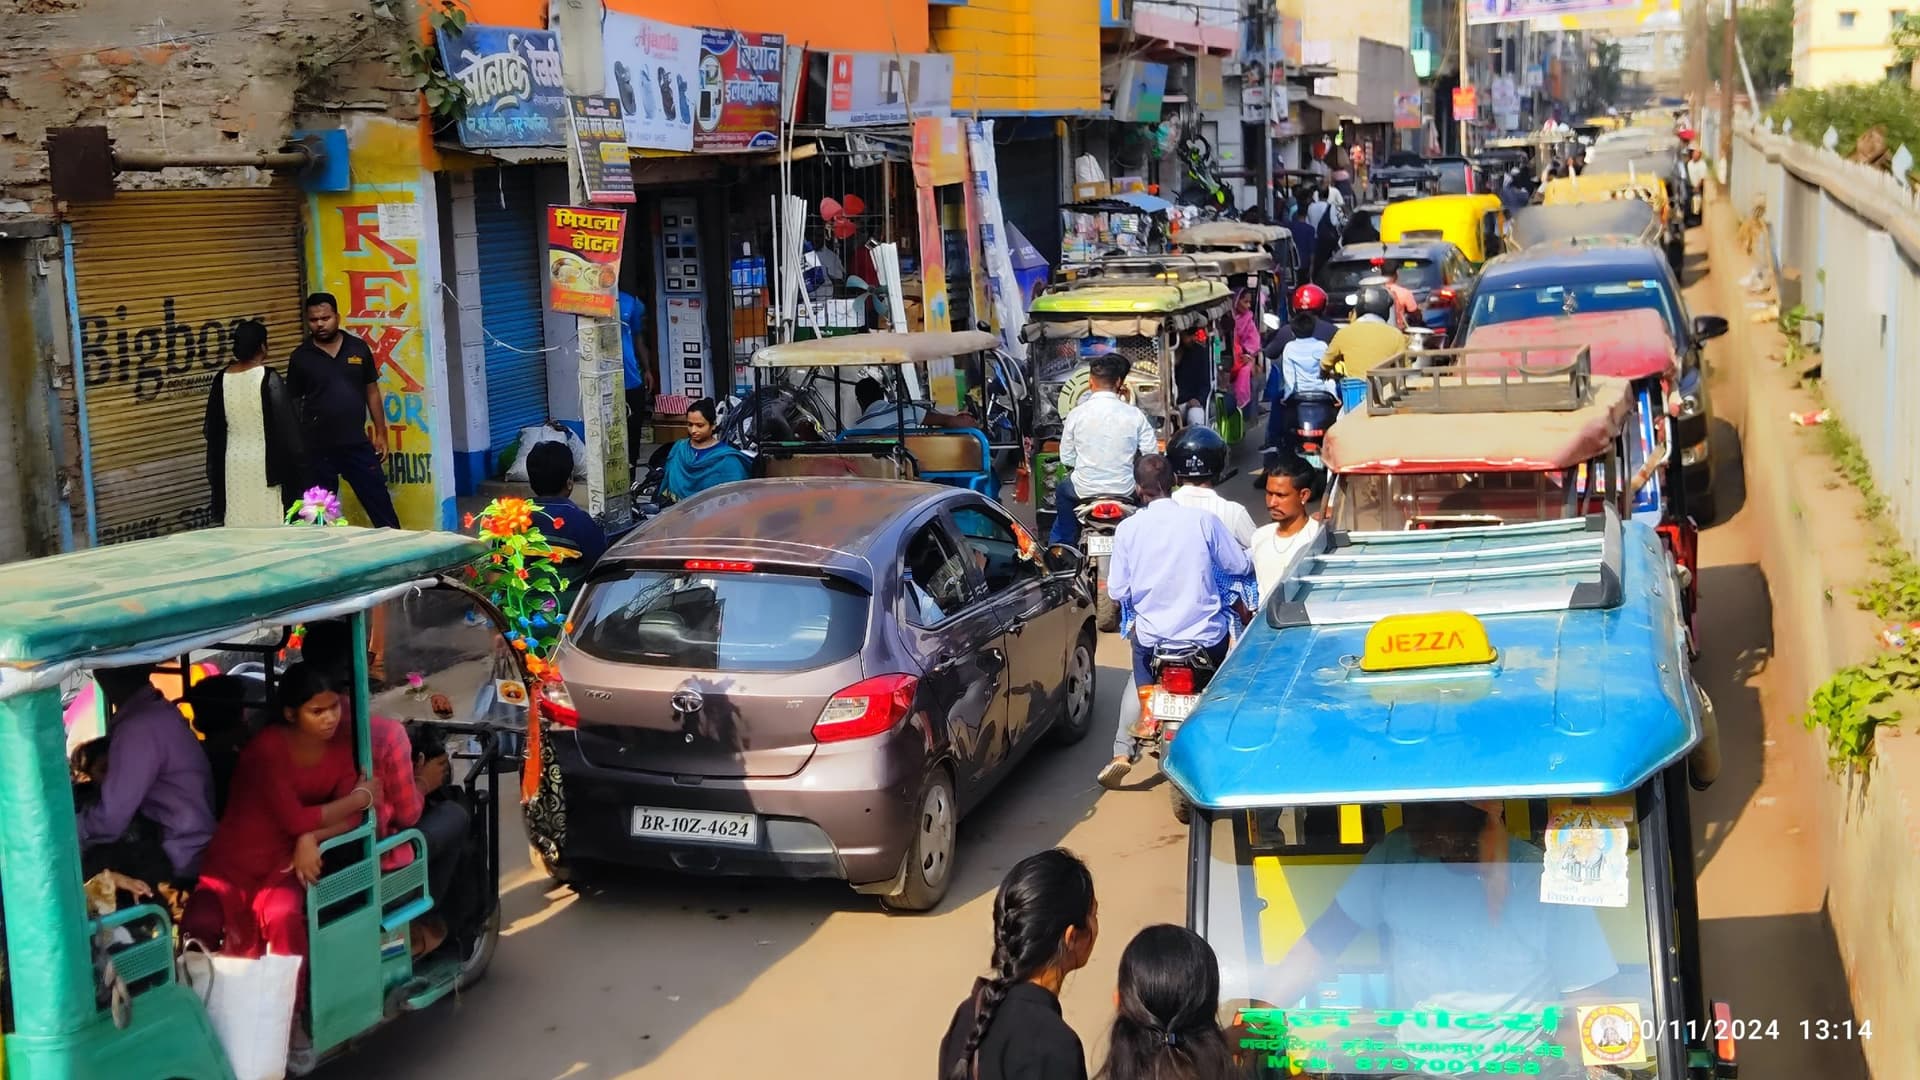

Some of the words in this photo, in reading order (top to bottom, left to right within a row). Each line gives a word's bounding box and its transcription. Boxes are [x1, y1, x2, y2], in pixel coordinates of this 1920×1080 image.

[570, 230, 620, 253] होटल
[1380, 631, 1465, 654] JEZZA
[640, 814, 749, 838] BR-10Z-4624
